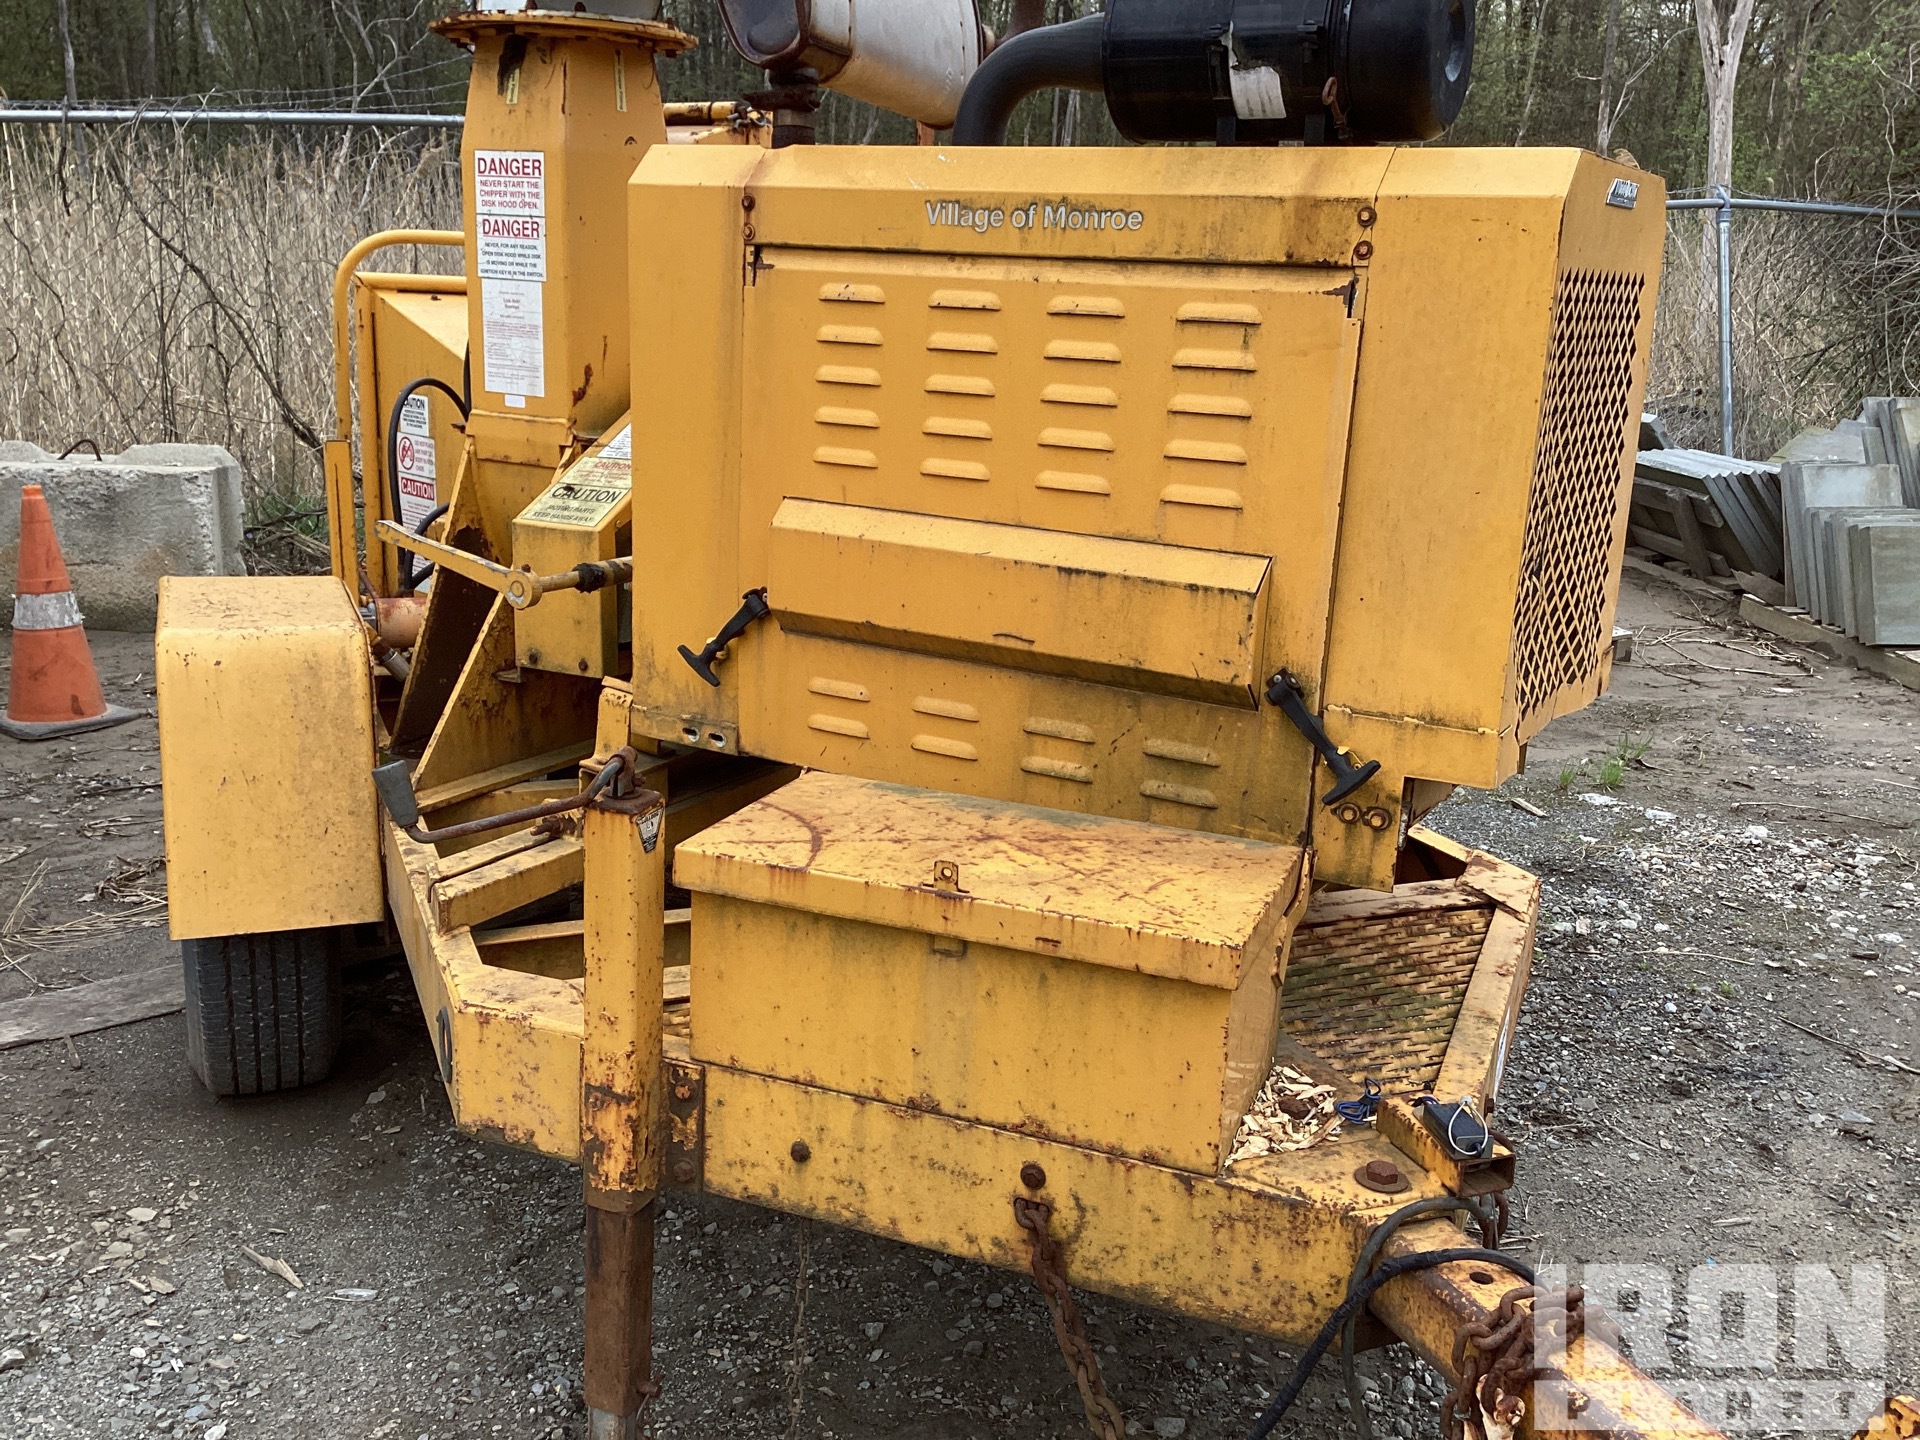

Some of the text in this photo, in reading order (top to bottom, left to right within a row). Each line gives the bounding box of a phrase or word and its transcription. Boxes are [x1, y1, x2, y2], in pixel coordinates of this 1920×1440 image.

[477, 157, 542, 176] DANGER
[480, 189, 540, 200] CHIPPER WITH THE
[482, 200, 496, 208] DISK
[925, 201, 1143, 233] Village of Monroe
[482, 218, 540, 238] DANGER
[403, 398, 425, 409] AUTION
[402, 478, 434, 500] CAUTION
[552, 486, 622, 503] CAUTION
